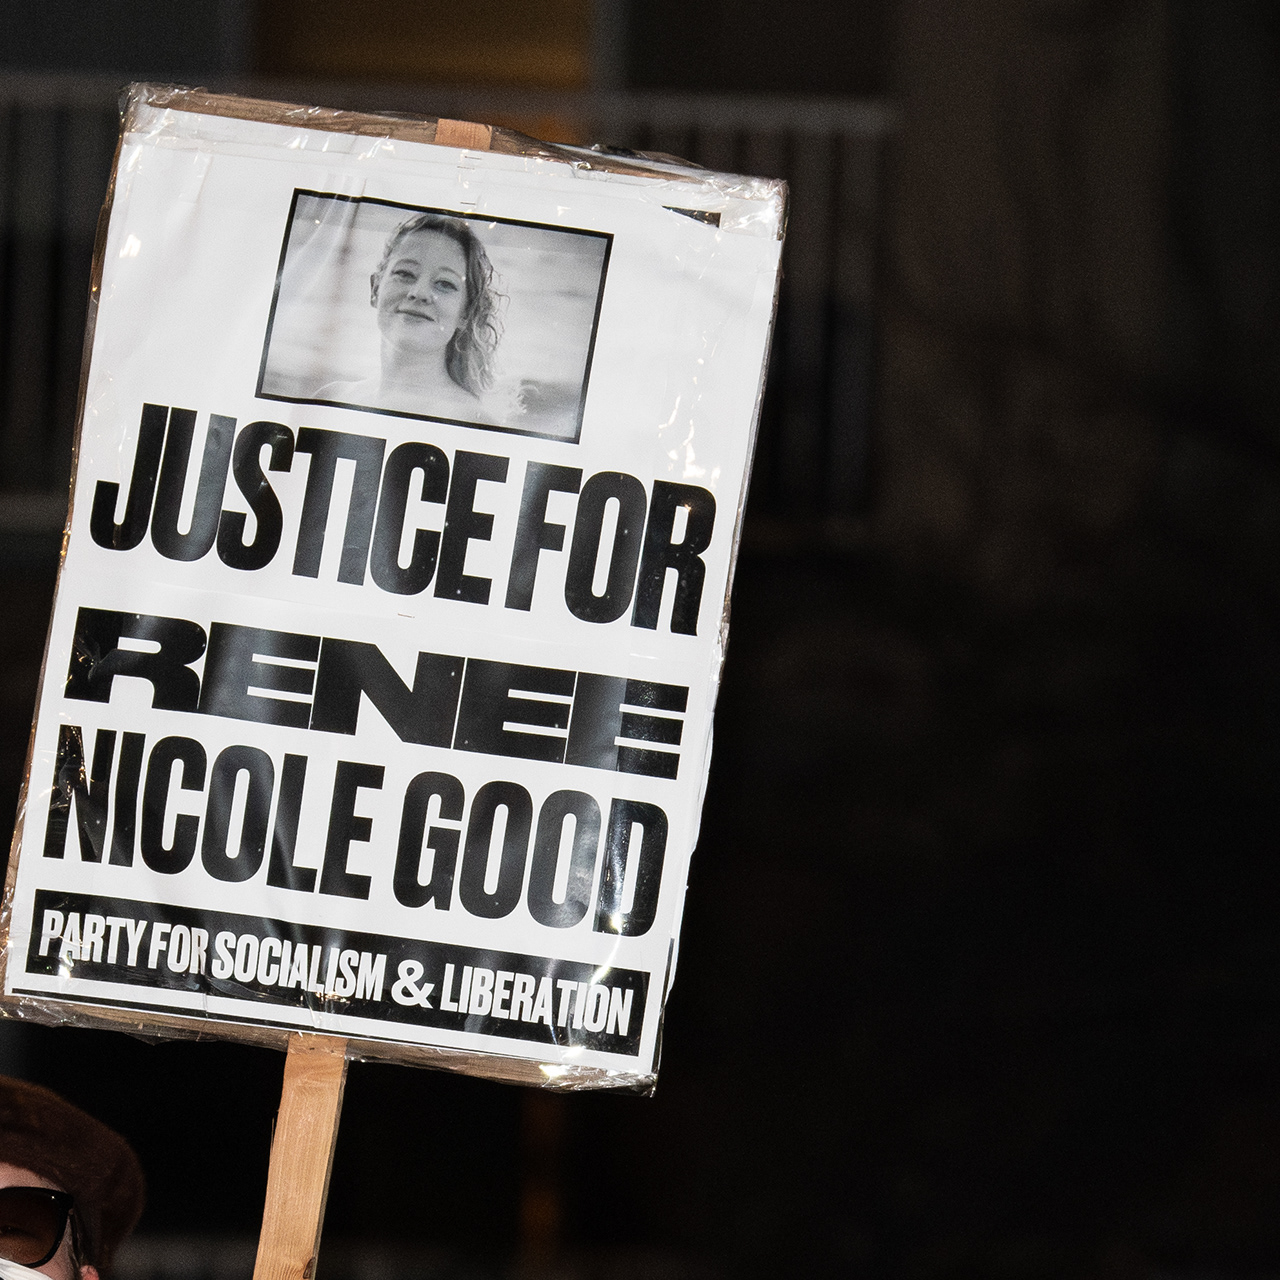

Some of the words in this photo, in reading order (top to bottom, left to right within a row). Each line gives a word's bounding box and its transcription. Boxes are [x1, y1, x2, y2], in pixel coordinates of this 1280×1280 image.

[90, 404, 508, 605] JUSTICE
[505, 461, 717, 637] FOR
[64, 606, 689, 780] RENEE
[43, 724, 385, 900] NICOLE
[393, 771, 670, 939] GOOD
[39, 909, 148, 965] PARTY
[150, 923, 208, 975] FOR
[212, 931, 387, 1004] SOCIALISM
[391, 958, 435, 1009] &
[440, 963, 634, 1038] LIBERATION
